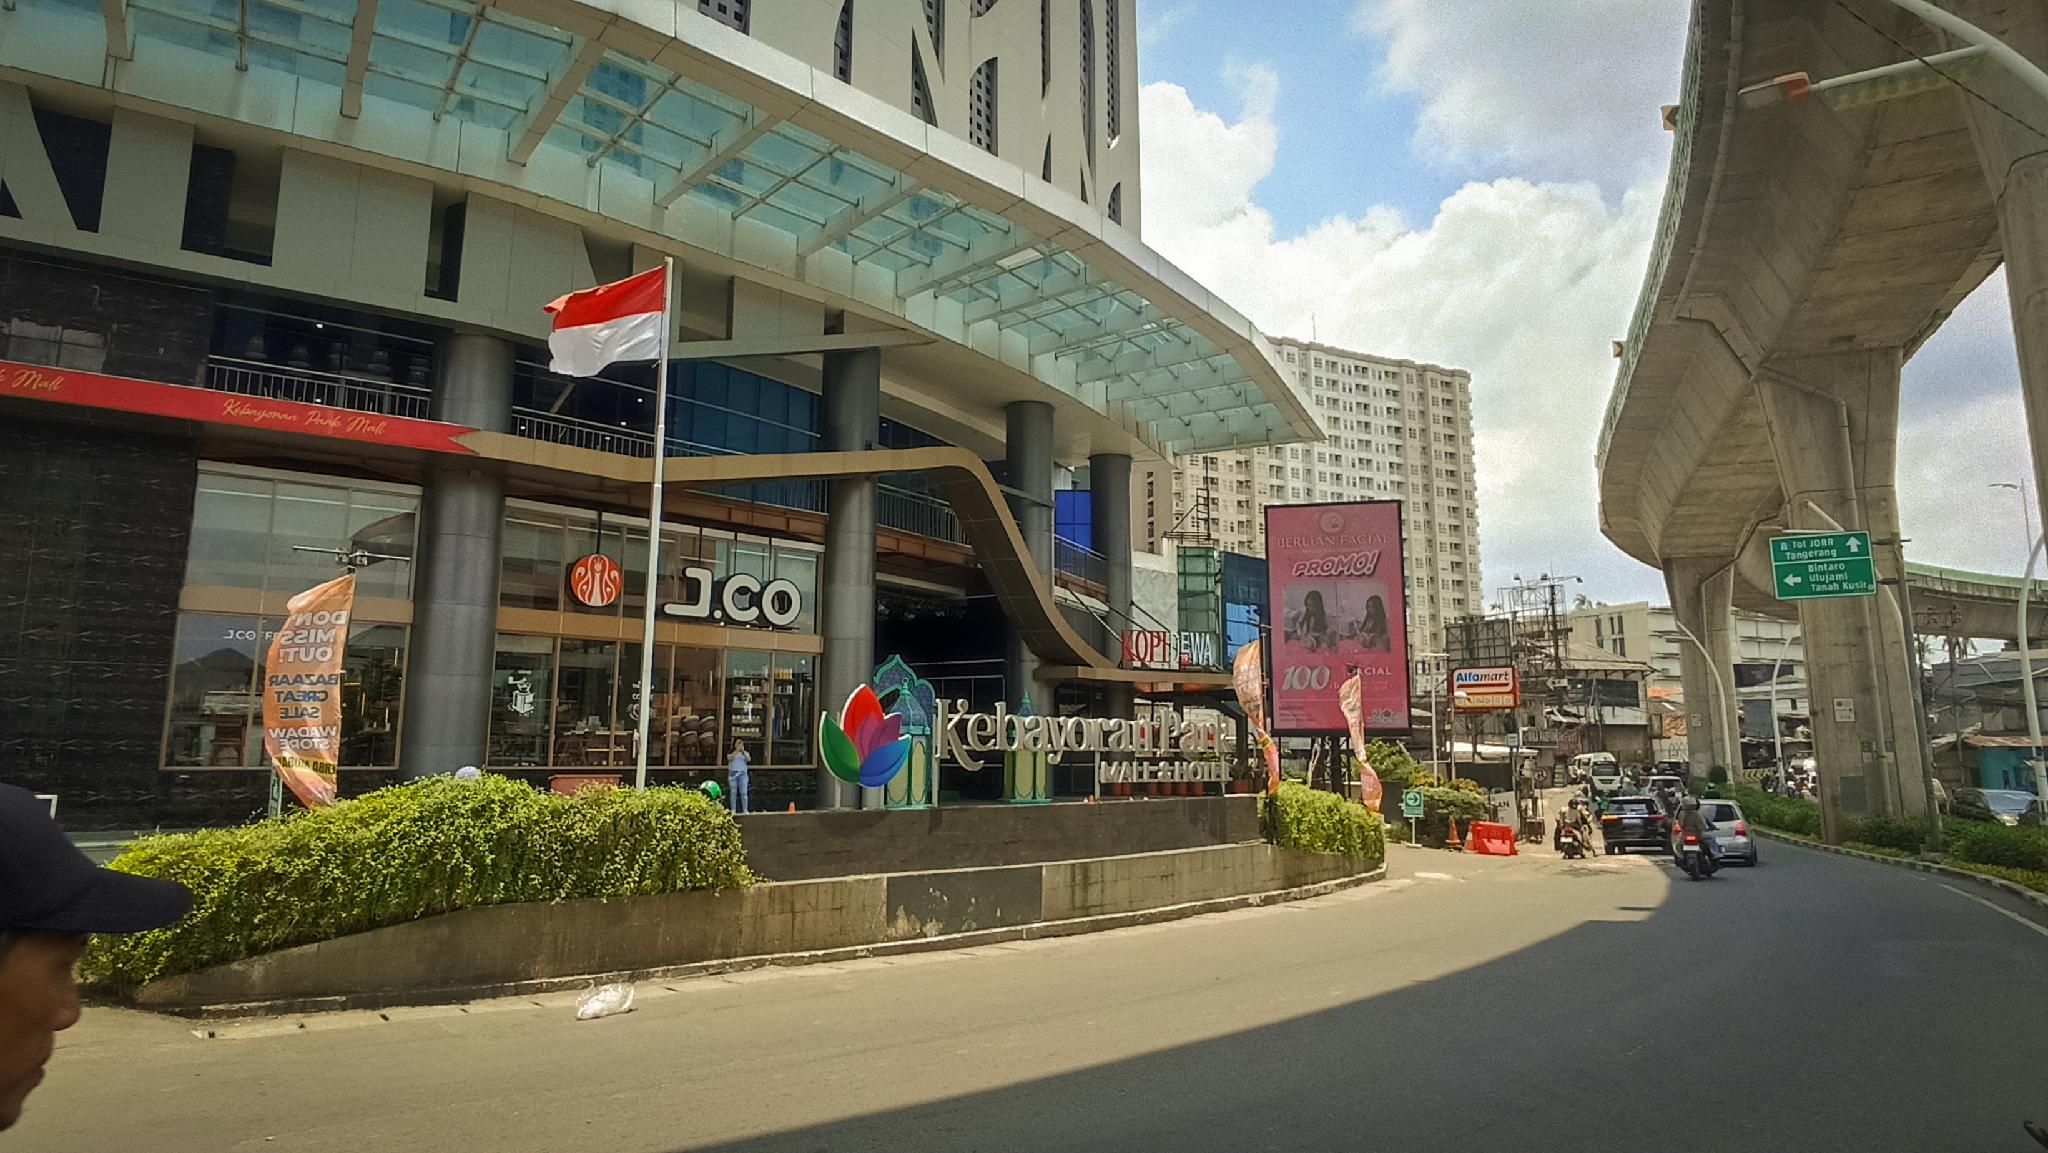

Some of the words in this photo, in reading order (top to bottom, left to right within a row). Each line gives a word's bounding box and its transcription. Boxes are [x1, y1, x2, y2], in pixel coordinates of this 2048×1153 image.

[12, 369, 65, 391] Mall
[305, 410, 342, 427] Park
[346, 416, 387, 435] Mall
[1340, 532, 1387, 546] FACIAL
[1792, 540, 1806, 549] Tol
[1810, 538, 1834, 548] JORR
[1292, 549, 1381, 577] PROMO!
[1785, 548, 1837, 561] Tangerang
[1807, 562, 1846, 573] Bintaro
[1808, 572, 1849, 583] Ulujami
[663, 566, 803, 627] J.CO
[1811, 582, 1840, 592] Tanah
[1842, 580, 1868, 590] Kusir
[1121, 629, 1168, 663] KOPI
[1170, 630, 1214, 667] DEWA
[1281, 665, 1331, 691] 100
[1353, 666, 1393, 676] ACIAL
[1456, 670, 1510, 682] Alfamart
[935, 698, 1150, 771] Kebayoran
[1100, 760, 1157, 783] MALL
[1173, 760, 1234, 783] HOTEL
